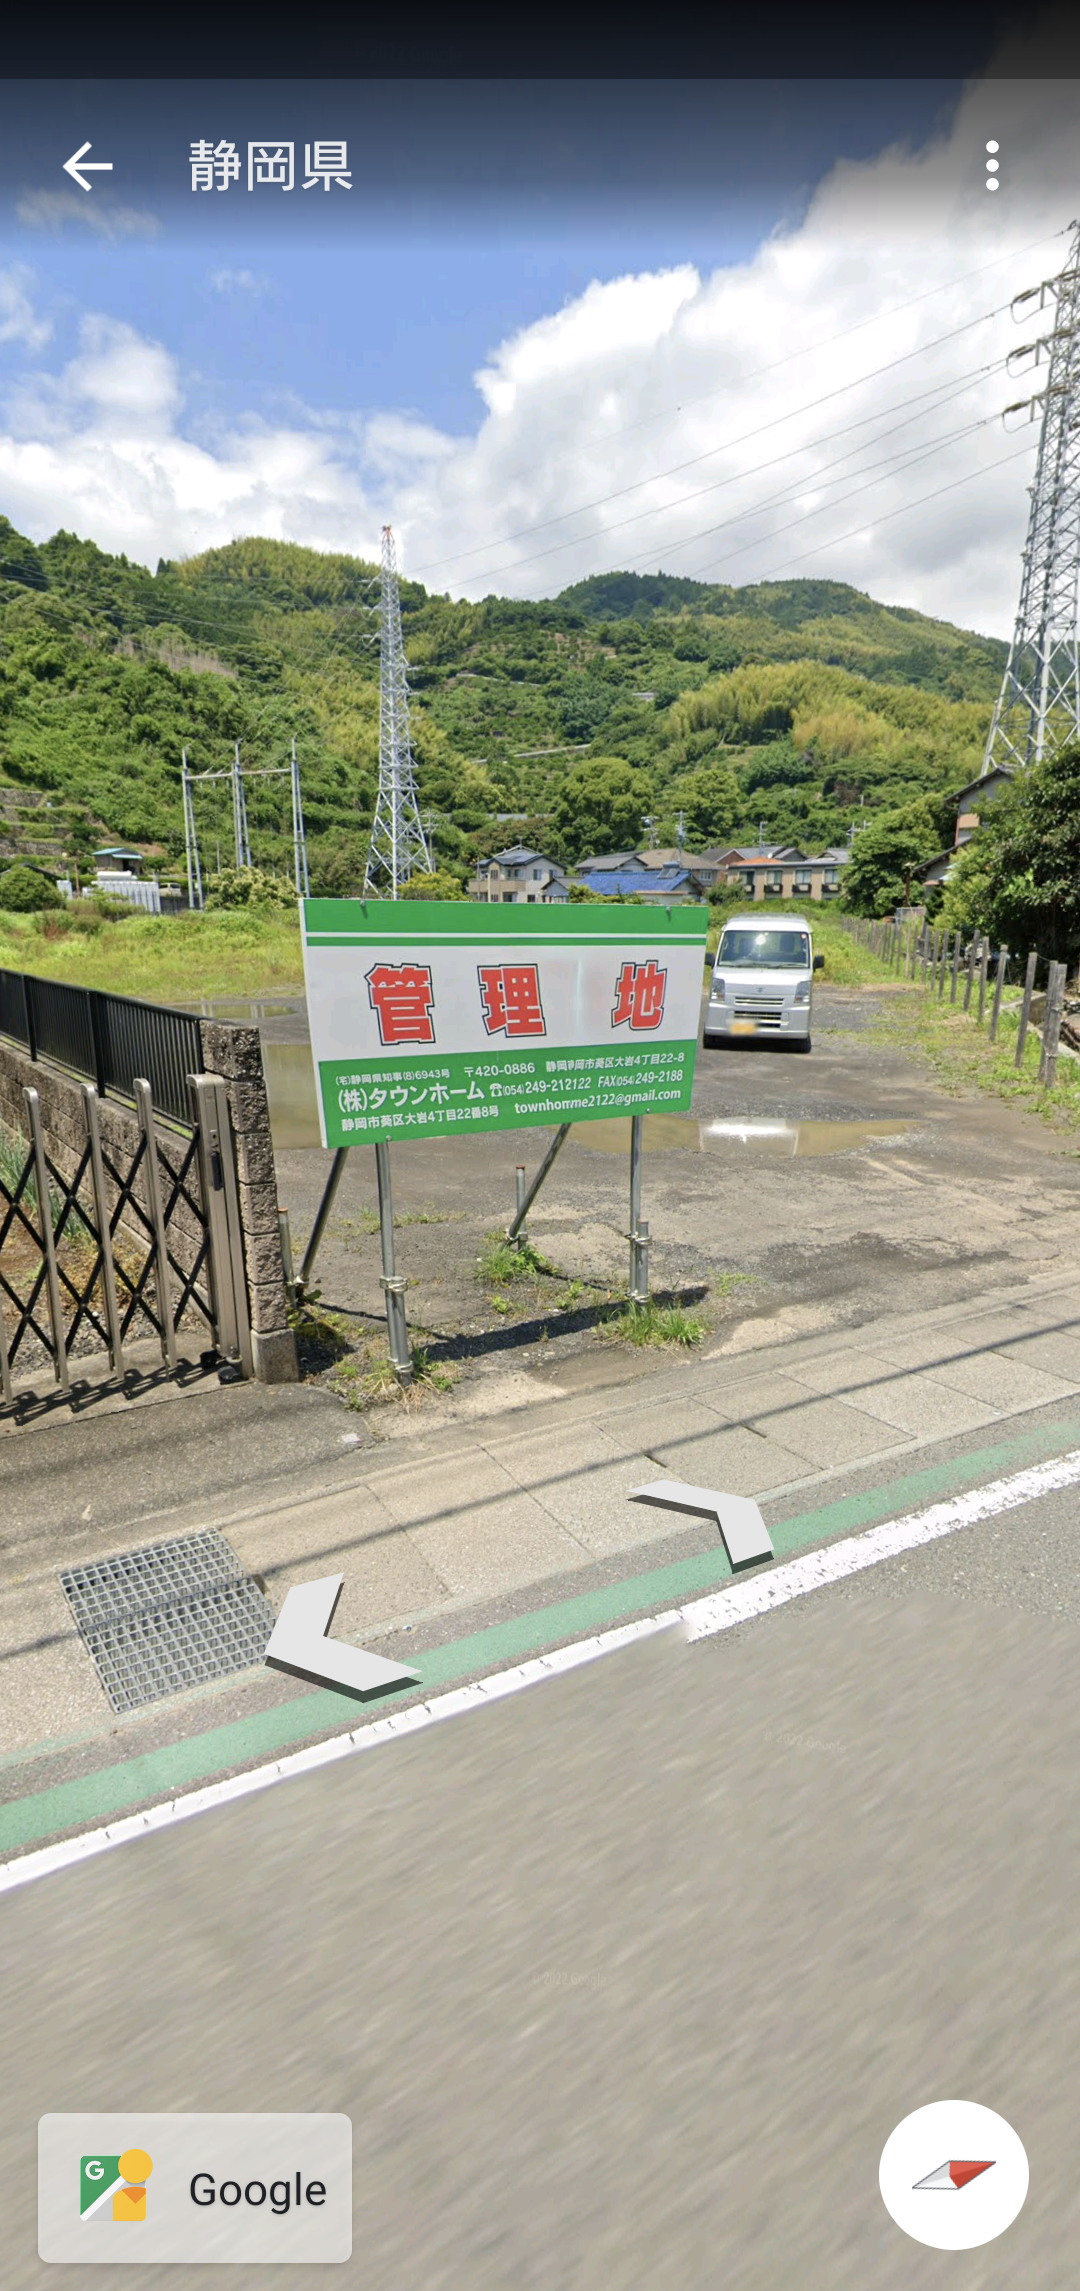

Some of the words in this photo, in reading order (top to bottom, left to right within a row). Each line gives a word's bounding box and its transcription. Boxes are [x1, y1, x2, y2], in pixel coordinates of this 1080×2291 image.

[364, 960, 667, 1046] 管理地
[338, 1080, 485, 1113] (株)タウンホーム
[341, 1105, 499, 1132] 静岡市葵区大岩4丁目22番8号
